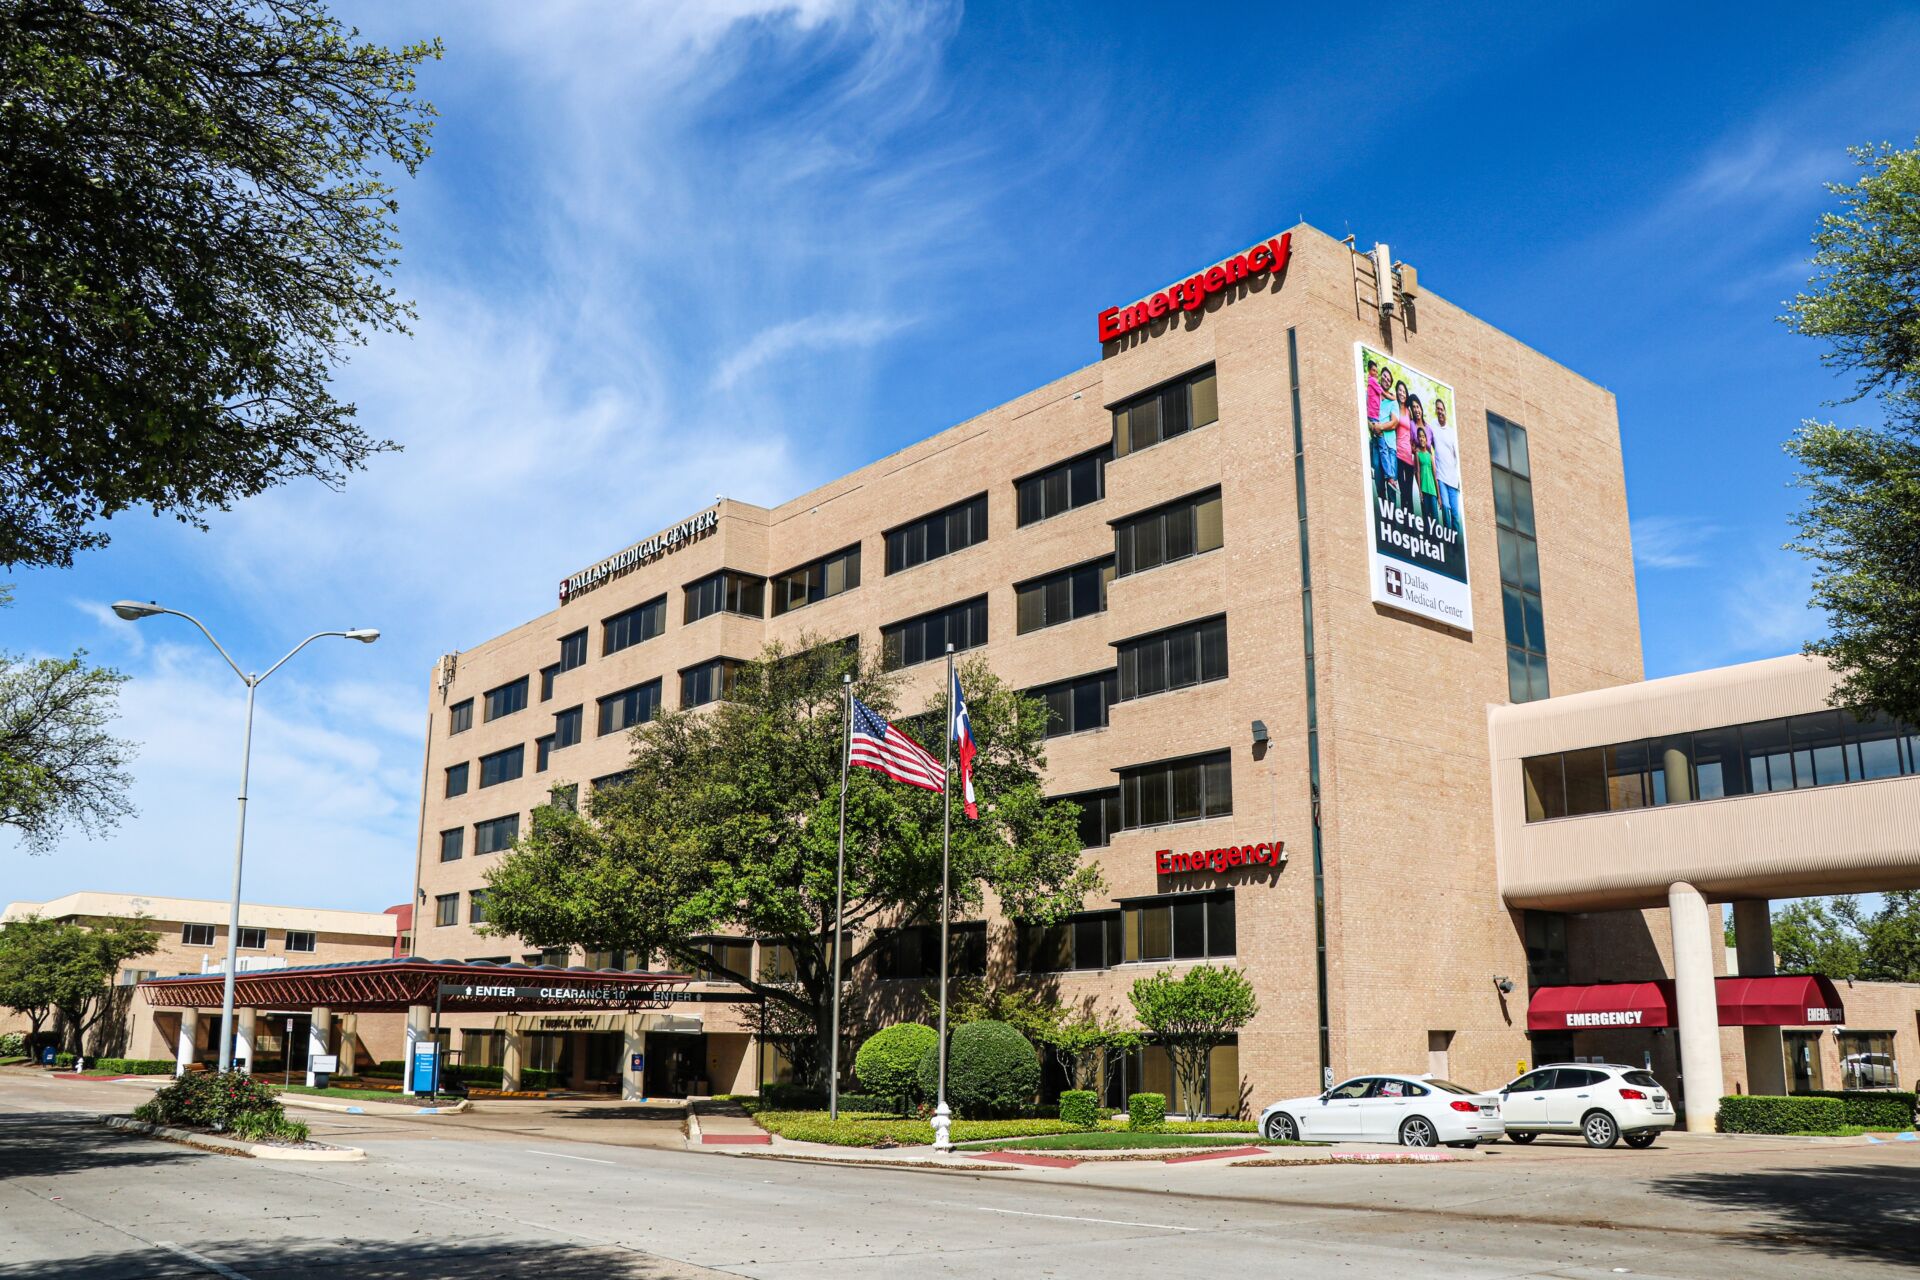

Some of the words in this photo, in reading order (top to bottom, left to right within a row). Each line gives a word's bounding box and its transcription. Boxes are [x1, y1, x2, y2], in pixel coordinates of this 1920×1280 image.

[1098, 232, 1292, 343] Emergency
[1378, 497, 1424, 532] We're
[1427, 516, 1458, 544] Your
[568, 564, 611, 593] DALLAS
[610, 537, 662, 571] MEDICAL
[664, 510, 717, 547] CENTER
[1380, 521, 1445, 563] Hospital
[1404, 572, 1429, 592] Dallas
[1405, 589, 1437, 610] Medical
[1438, 600, 1463, 619] Center
[1155, 841, 1285, 875] Emergency
[475, 986, 516, 997] ENTER
[540, 988, 610, 1000] CLEARANCE
[653, 991, 692, 1001] ENTER
[1566, 1011, 1643, 1026] EMERGENCY
[1807, 1007, 1842, 1022] EMERGENCY
